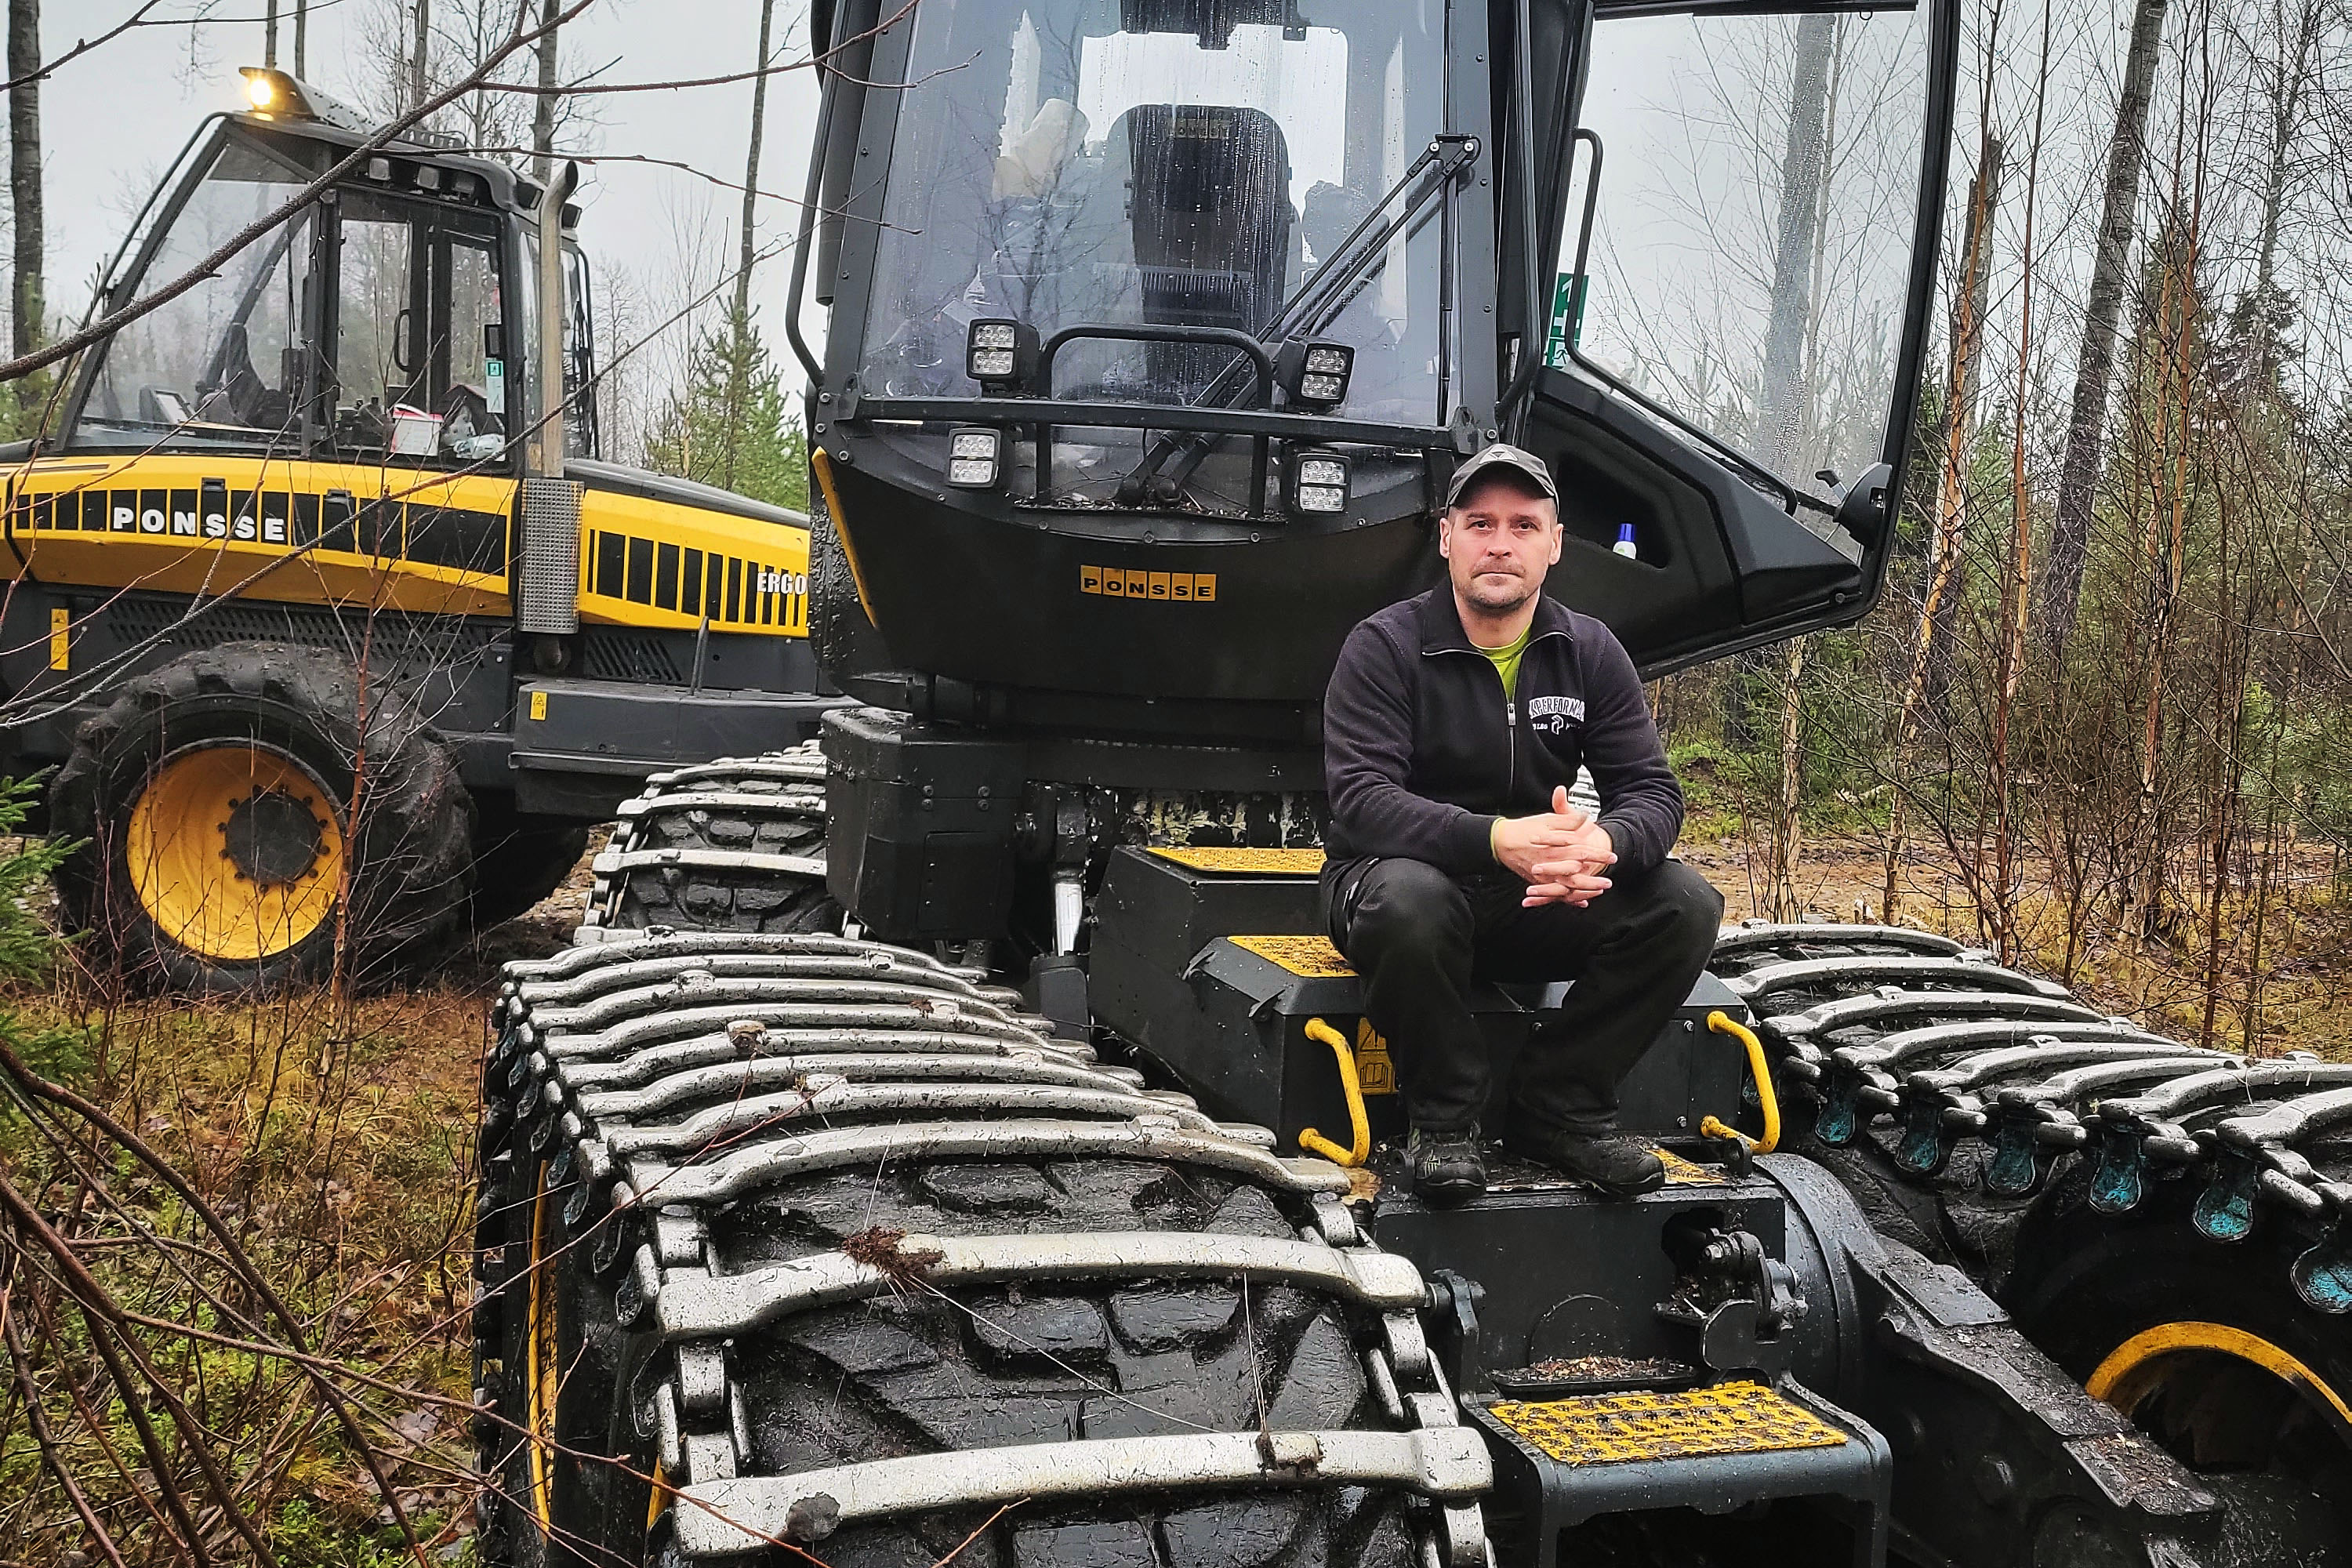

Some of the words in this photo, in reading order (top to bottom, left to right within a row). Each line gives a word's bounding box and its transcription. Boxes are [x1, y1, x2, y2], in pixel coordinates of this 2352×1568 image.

[113, 506, 285, 542] PONSSE
[757, 572, 808, 595] ERGO
[1083, 577, 1211, 597] PONSSE
